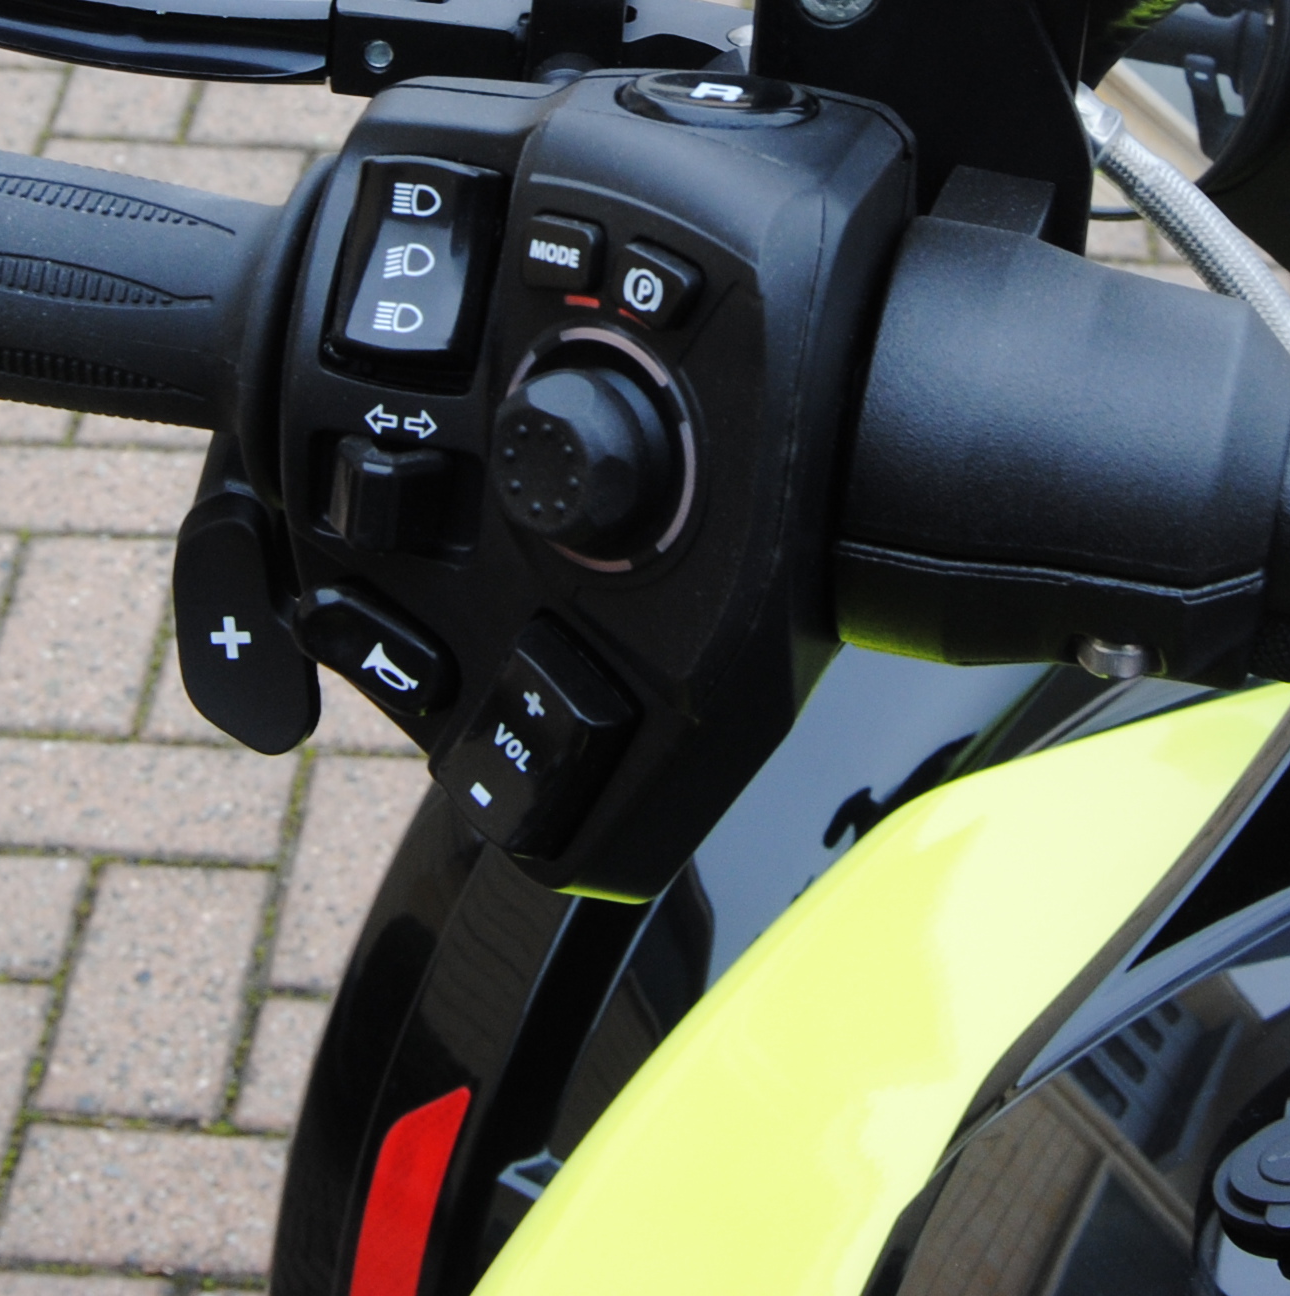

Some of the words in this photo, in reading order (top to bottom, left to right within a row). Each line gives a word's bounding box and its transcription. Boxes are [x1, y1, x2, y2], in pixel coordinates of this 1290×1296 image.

[690, 81, 744, 102] R
[529, 239, 580, 269] MODE
[636, 277, 653, 301] P
[494, 722, 531, 772] VOL
